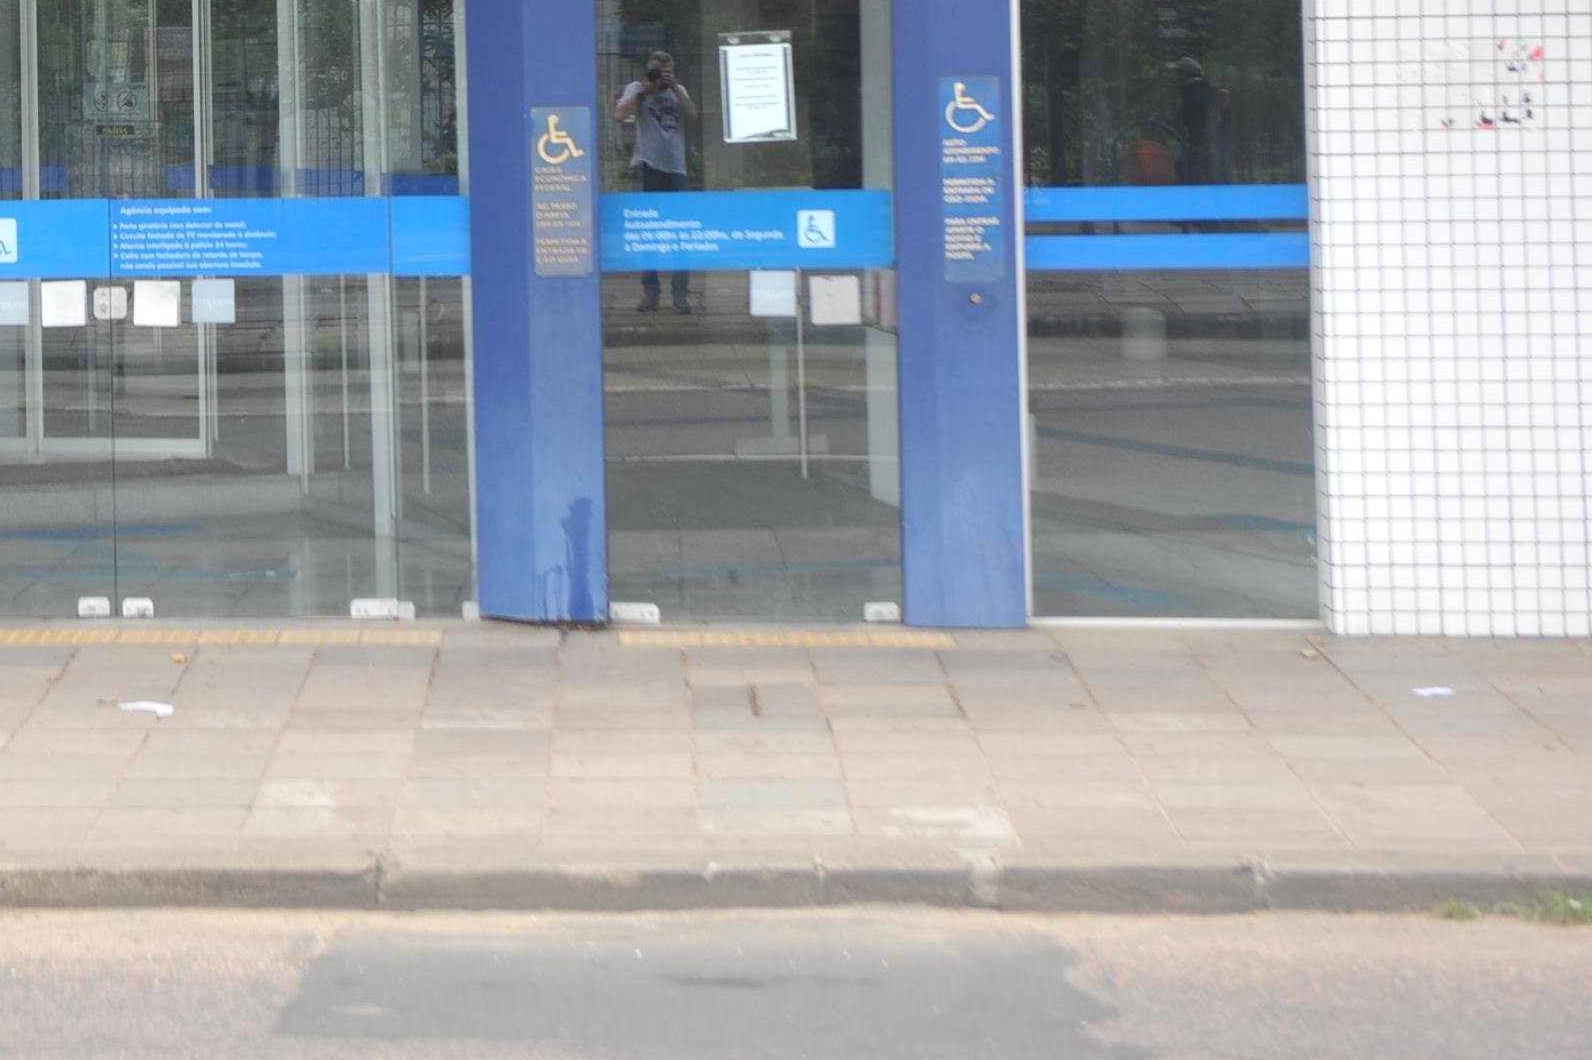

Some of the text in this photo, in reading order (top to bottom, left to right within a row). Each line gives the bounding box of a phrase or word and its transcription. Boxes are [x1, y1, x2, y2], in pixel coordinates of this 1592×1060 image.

[119, 206, 152, 217] Agência
[153, 206, 192, 216] equipada
[623, 208, 658, 218] Entrada
[119, 222, 137, 231] Porta
[138, 221, 168, 231] giratória
[185, 221, 213, 229] detector
[119, 231, 146, 240] Circuito
[176, 231, 185, 239] de
[185, 231, 195, 239] TV
[744, 228, 784, 241] Segunda
[119, 241, 145, 250] Alarme
[119, 251, 139, 260] Cofre
[119, 261, 134, 270] não
[134, 261, 156, 270] sendo
